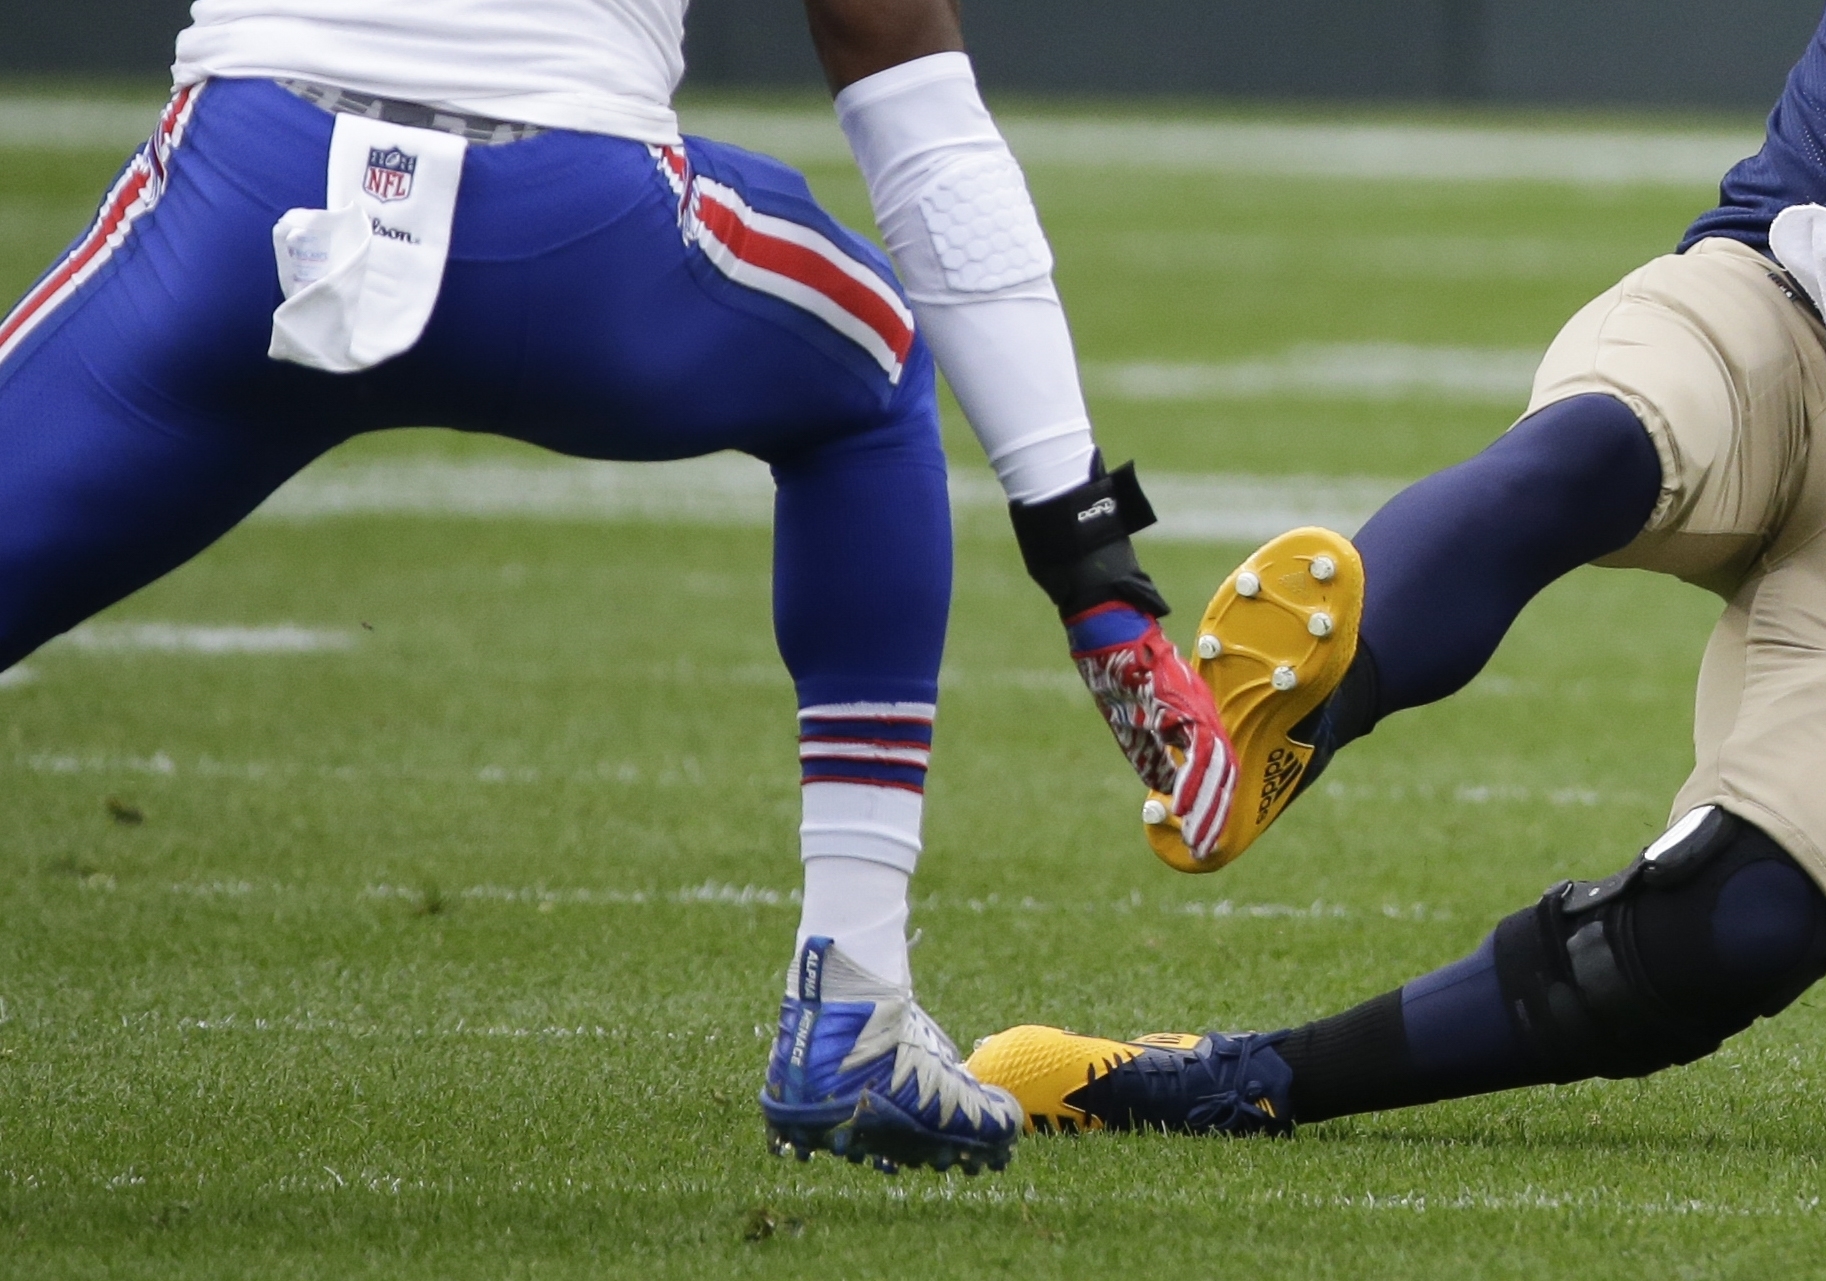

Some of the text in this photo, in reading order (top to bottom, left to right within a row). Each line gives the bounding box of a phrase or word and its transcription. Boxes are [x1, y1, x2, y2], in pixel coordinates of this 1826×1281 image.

[368, 167, 406, 198] NFL
[1256, 748, 1285, 825] adidas
[790, 949, 819, 1067] ALPHA MENACE
